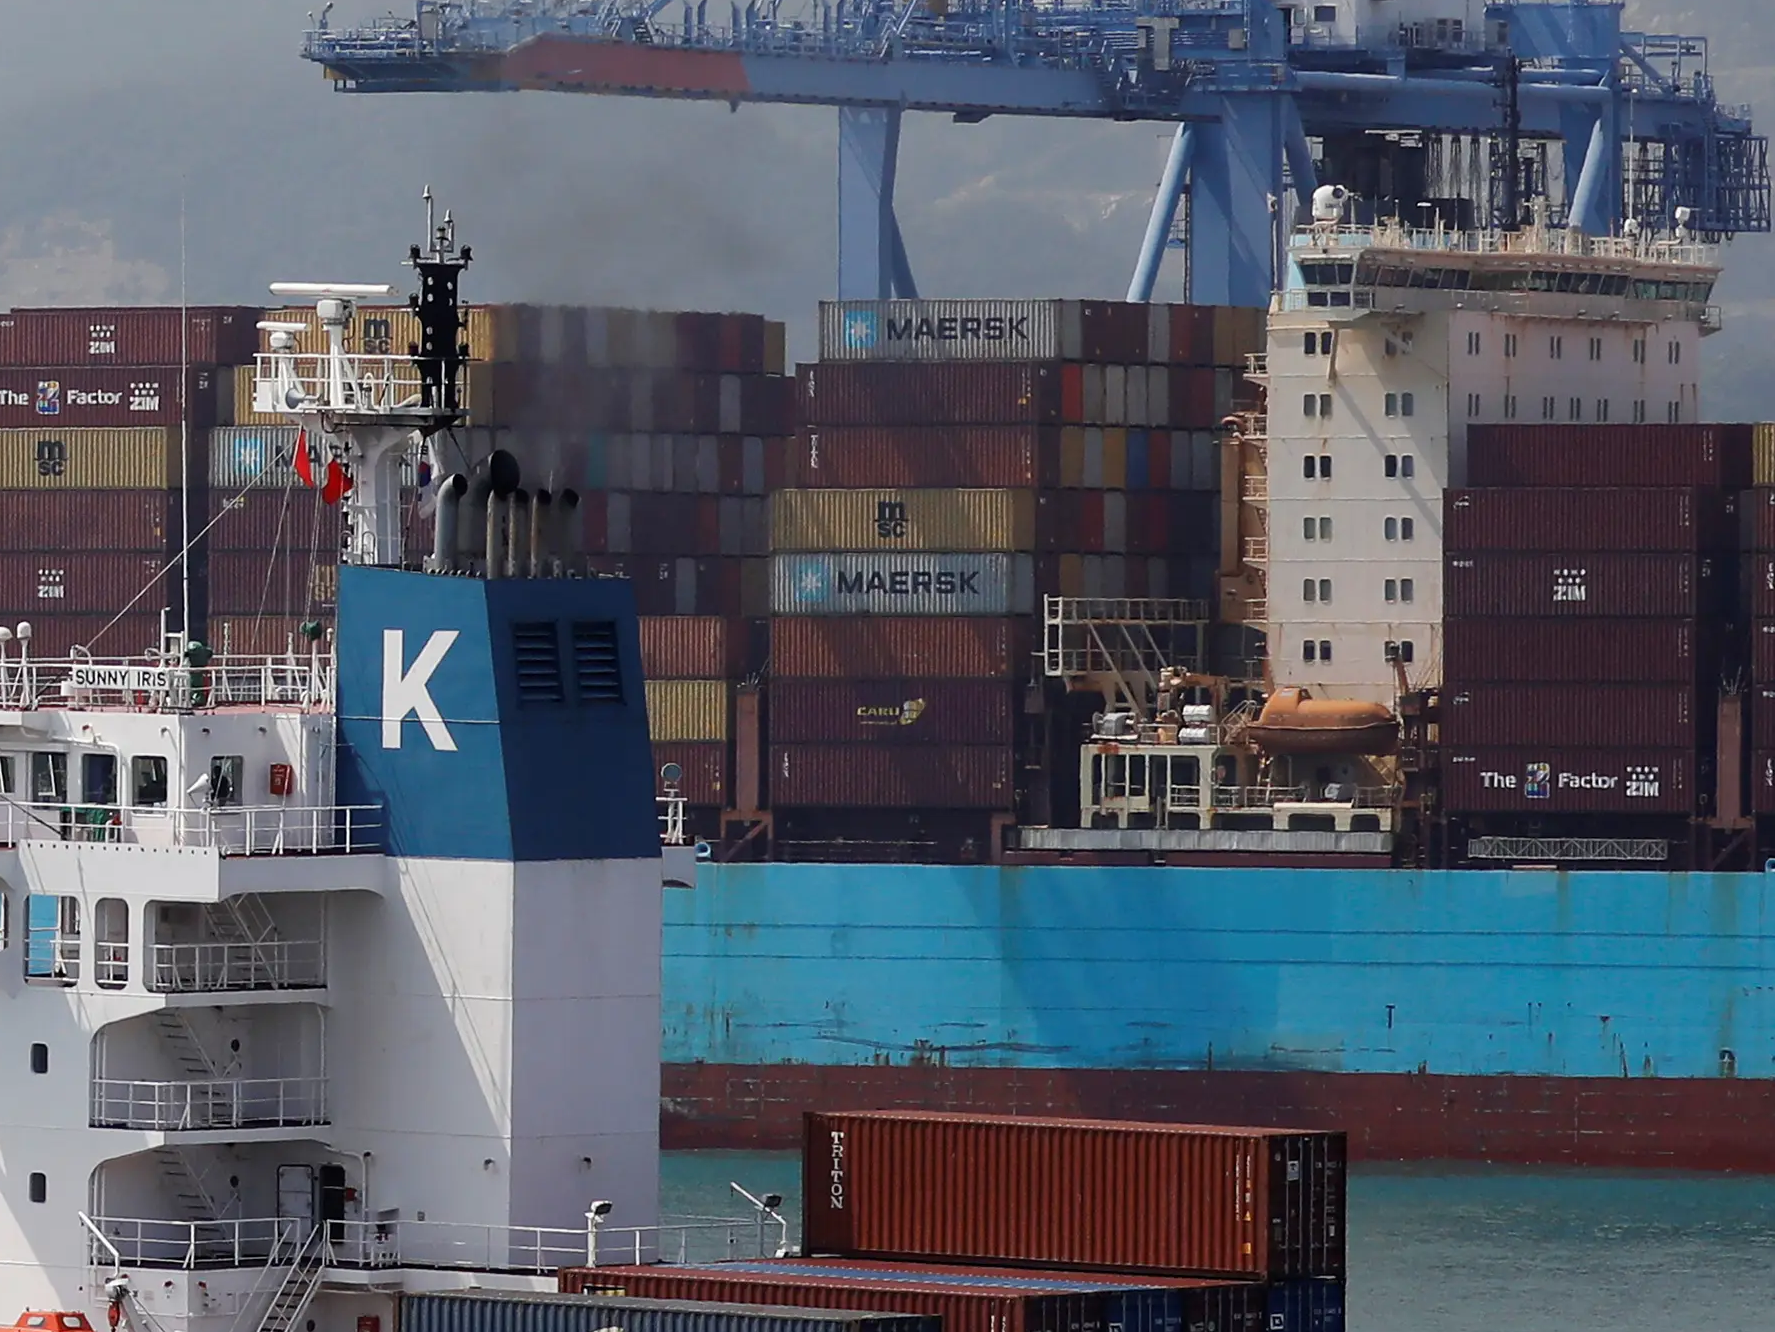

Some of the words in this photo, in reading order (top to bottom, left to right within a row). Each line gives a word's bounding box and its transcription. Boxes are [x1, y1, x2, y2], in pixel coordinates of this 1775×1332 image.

[887, 318, 1027, 340] MAERSK
[67, 389, 122, 405] Factor
[837, 571, 979, 594] MAERSK
[75, 669, 127, 685] SUNNY
[137, 671, 166, 687] IRIS
[382, 628, 460, 753] K
[1480, 772, 1517, 789] The
[1558, 772, 1619, 789] Factor
[830, 1131, 845, 1209] TRITON
